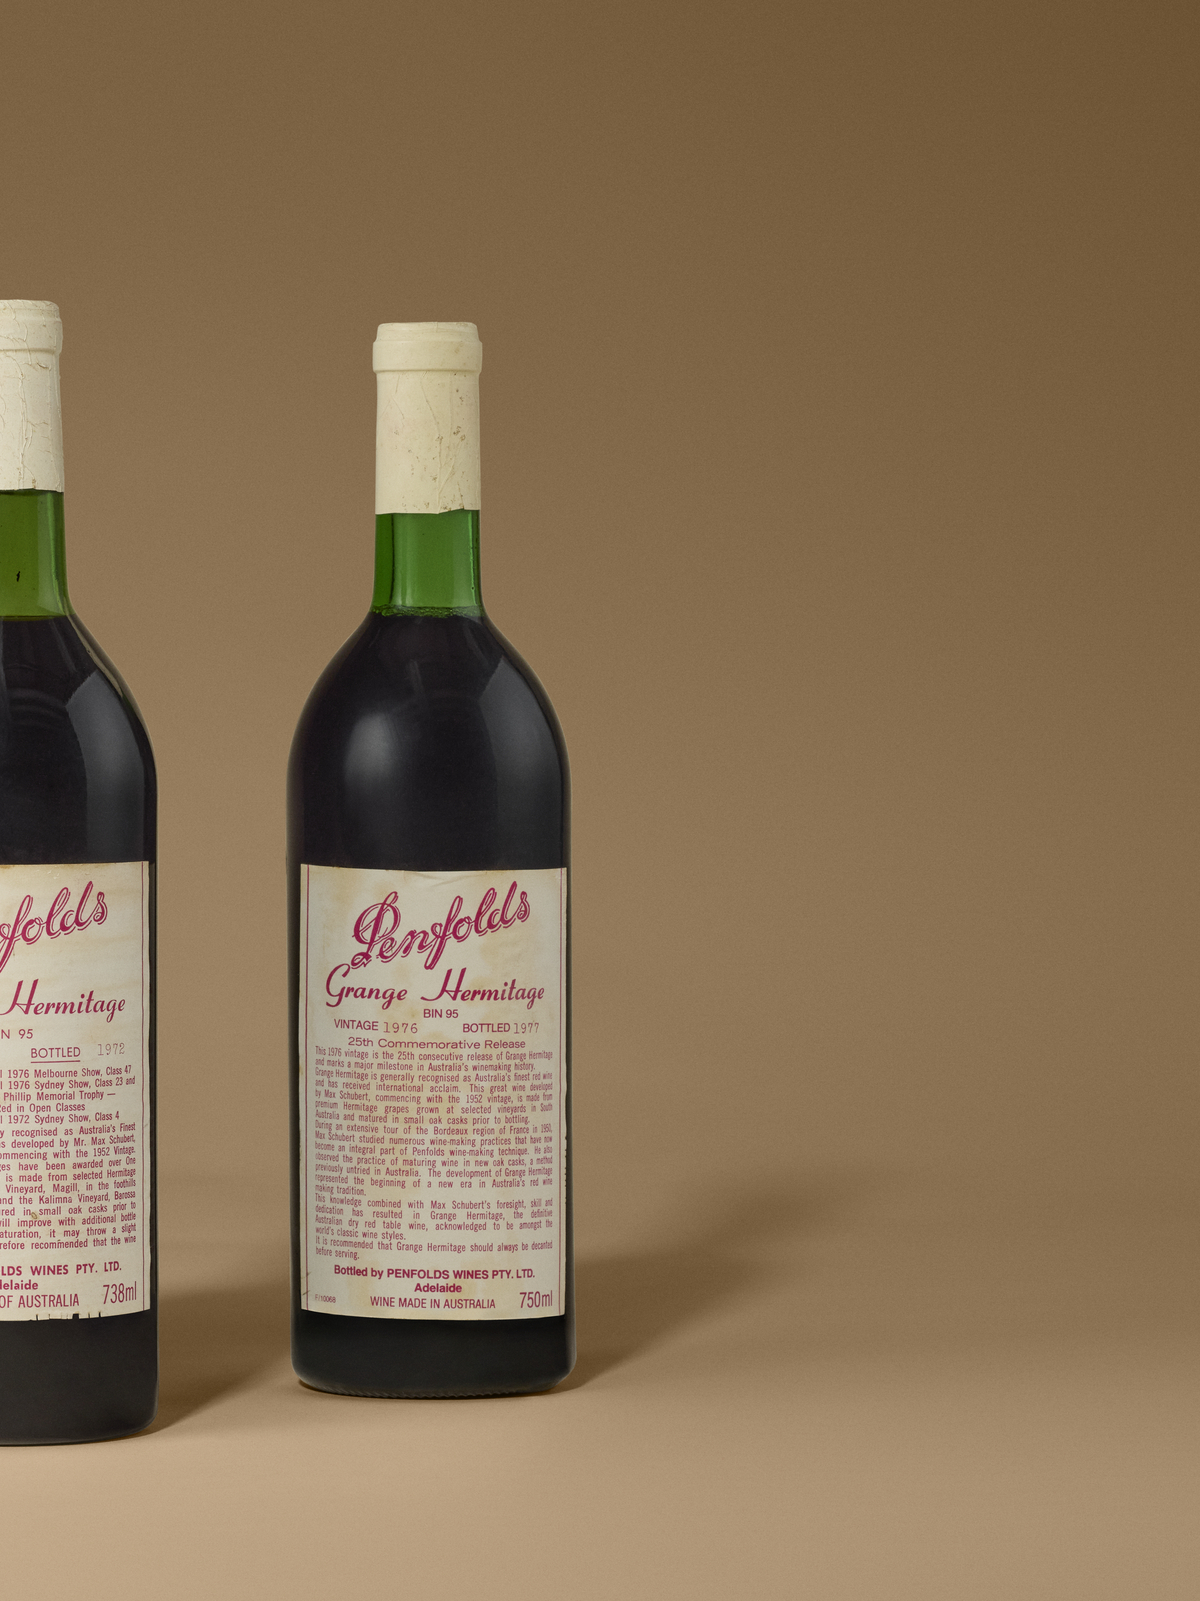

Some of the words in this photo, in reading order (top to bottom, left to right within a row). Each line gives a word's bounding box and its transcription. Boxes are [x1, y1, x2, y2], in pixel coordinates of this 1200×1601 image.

[351, 881, 530, 970] Penfolds
[326, 963, 407, 1010] Grange
[420, 967, 544, 1010] Hermitage
[423, 1009, 442, 1018] BIN
[446, 1009, 458, 1018] 95
[334, 1019, 379, 1031] VINTAGE
[383, 1022, 418, 1034] 1976
[463, 1023, 510, 1033] BOTTLED
[514, 1022, 539, 1034] 1977
[18, 1029, 33, 1039] 95
[348, 1037, 373, 1046] 25th
[378, 1038, 480, 1049] Commemorative
[485, 1040, 525, 1049] Release
[31, 1047, 81, 1058] BOTTLED
[98, 1043, 124, 1055] 1972
[8, 1069, 29, 1078] 1976
[34, 1069, 78, 1078] Melbourne
[82, 1068, 102, 1077] Show,
[106, 1067, 122, 1075] Class
[124, 1065, 131, 1074] 47
[315, 1058, 324, 1067] and
[327, 1059, 344, 1067] marks
[354, 1062, 373, 1070] major
[377, 1062, 413, 1071] milestone
[417, 1062, 424, 1072] in
[428, 1063, 468, 1071] Australia's
[472, 1063, 511, 1072] winemaking
[514, 1061, 535, 1071] history.
[9, 1080, 30, 1089] 1976
[35, 1080, 64, 1091] Sydney
[69, 1080, 91, 1088] Show,
[95, 1078, 112, 1087] Class
[116, 1077, 123, 1086] 23
[126, 1076, 135, 1085] and
[4, 1092, 31, 1102] Phillip
[37, 1091, 75, 1100] Memorial
[79, 1090, 104, 1100] Trophy
[17, 1104, 24, 1112] in
[29, 1103, 51, 1113] Open
[56, 1103, 85, 1112] Classes
[9, 1115, 29, 1124] 1972
[35, 1114, 64, 1125] Sydney
[69, 1114, 91, 1123] Show,
[95, 1112, 112, 1121] Class
[115, 1111, 119, 1119] 4
[315, 1226, 334, 1236] world's
[337, 1228, 358, 1237] classic
[382, 1231, 406, 1241] styles.
[316, 1247, 332, 1256] before
[335, 1250, 359, 1261] serving.
[30, 1264, 69, 1276] WINES
[76, 1263, 97, 1274] PTY.
[104, 1261, 121, 1272] LTD.
[334, 1265, 368, 1277] Bottled
[371, 1268, 384, 1280] by
[387, 1268, 450, 1279] PENFOLDS
[453, 1270, 489, 1279] WINES
[492, 1269, 514, 1279] PTY.
[516, 1268, 535, 1279] LTD.
[103, 1281, 136, 1304] 738ml
[414, 1283, 462, 1293] Adelaide
[18, 1294, 79, 1308] AUSTRALIA
[370, 1296, 395, 1307] WINE
[399, 1297, 426, 1308] MADE
[430, 1299, 440, 1309] IN
[443, 1299, 495, 1309] AUSTRALIA
[519, 1290, 552, 1308] 750ml
